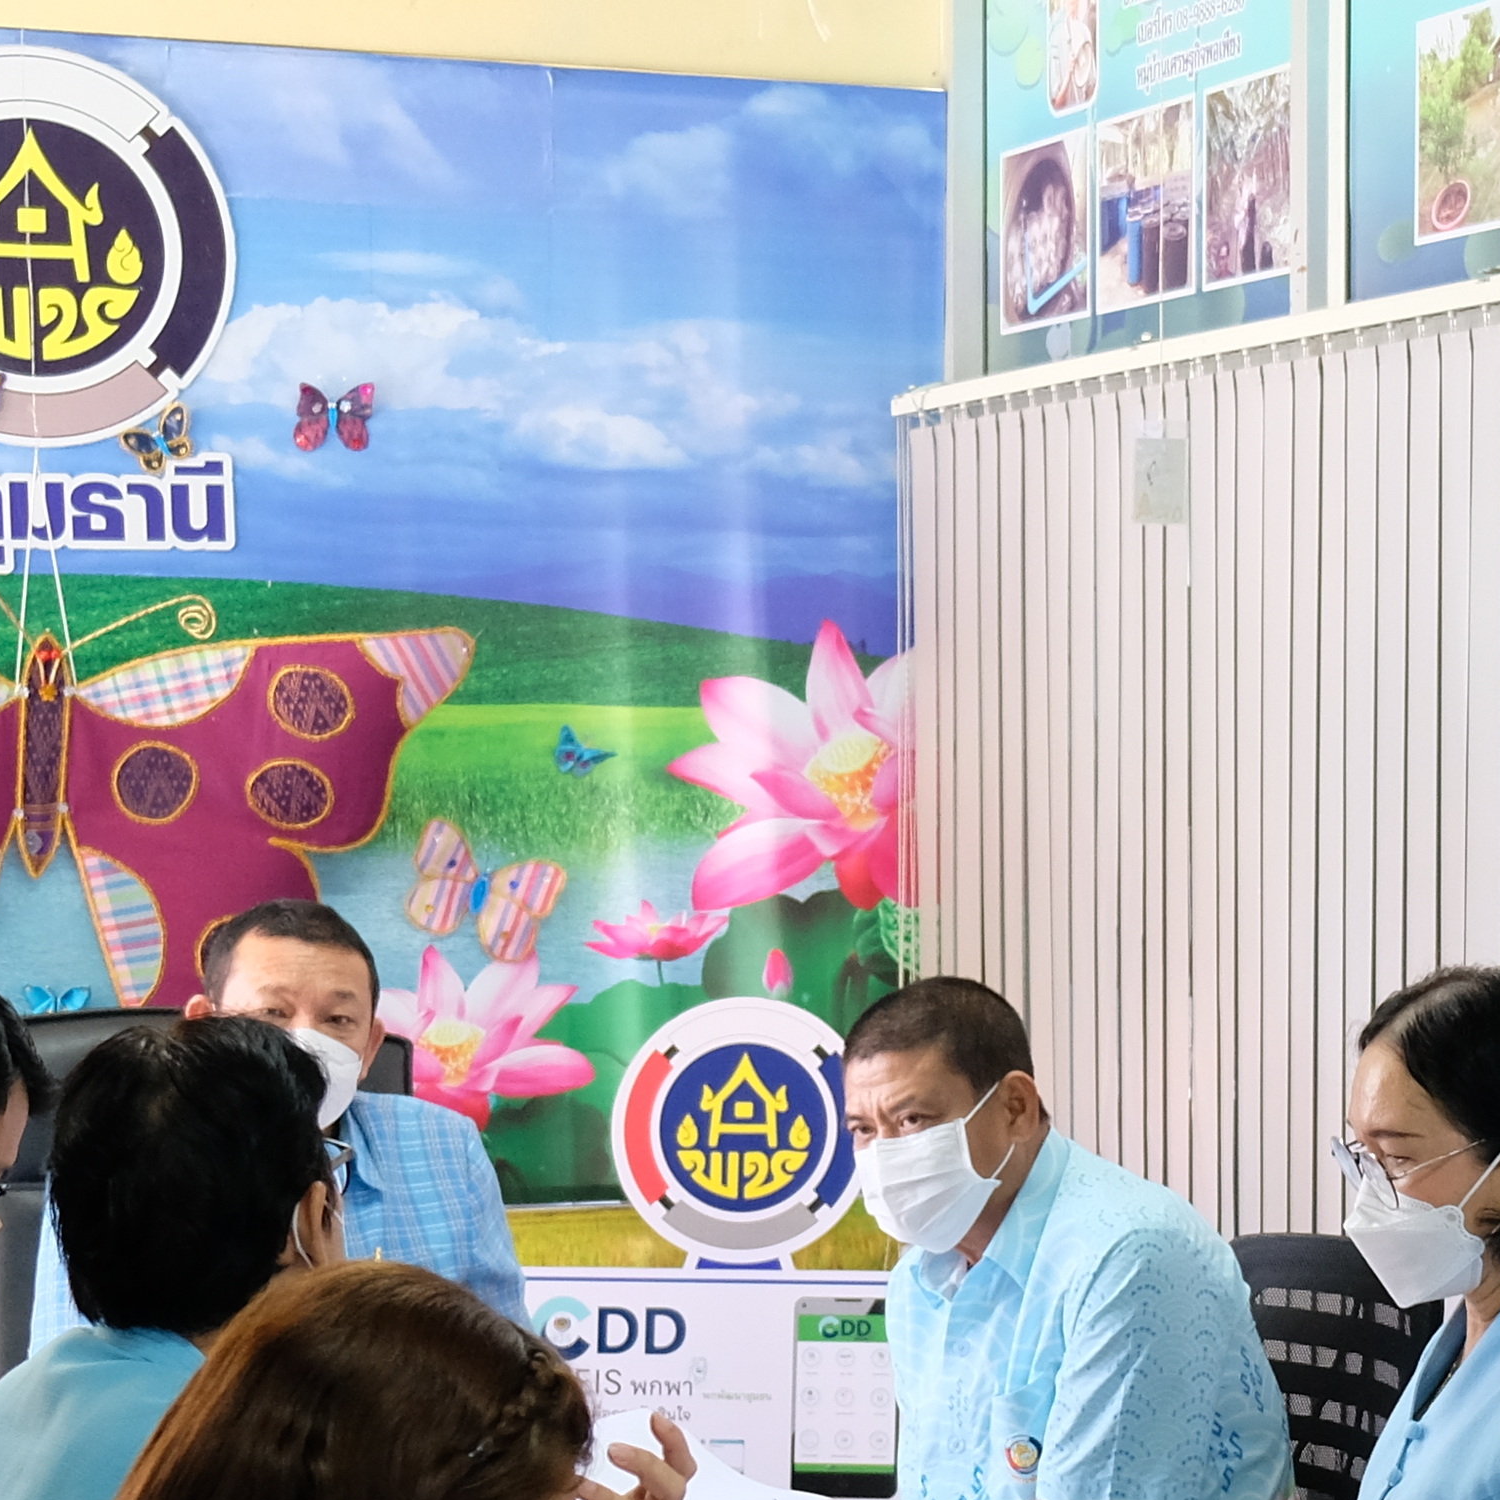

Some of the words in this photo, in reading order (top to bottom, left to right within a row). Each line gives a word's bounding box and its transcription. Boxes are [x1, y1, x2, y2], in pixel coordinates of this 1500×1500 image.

[531, 1295, 687, 1361] CDD
[818, 1315, 871, 1338] CDD
[630, 1379, 693, 1397] พกพา
